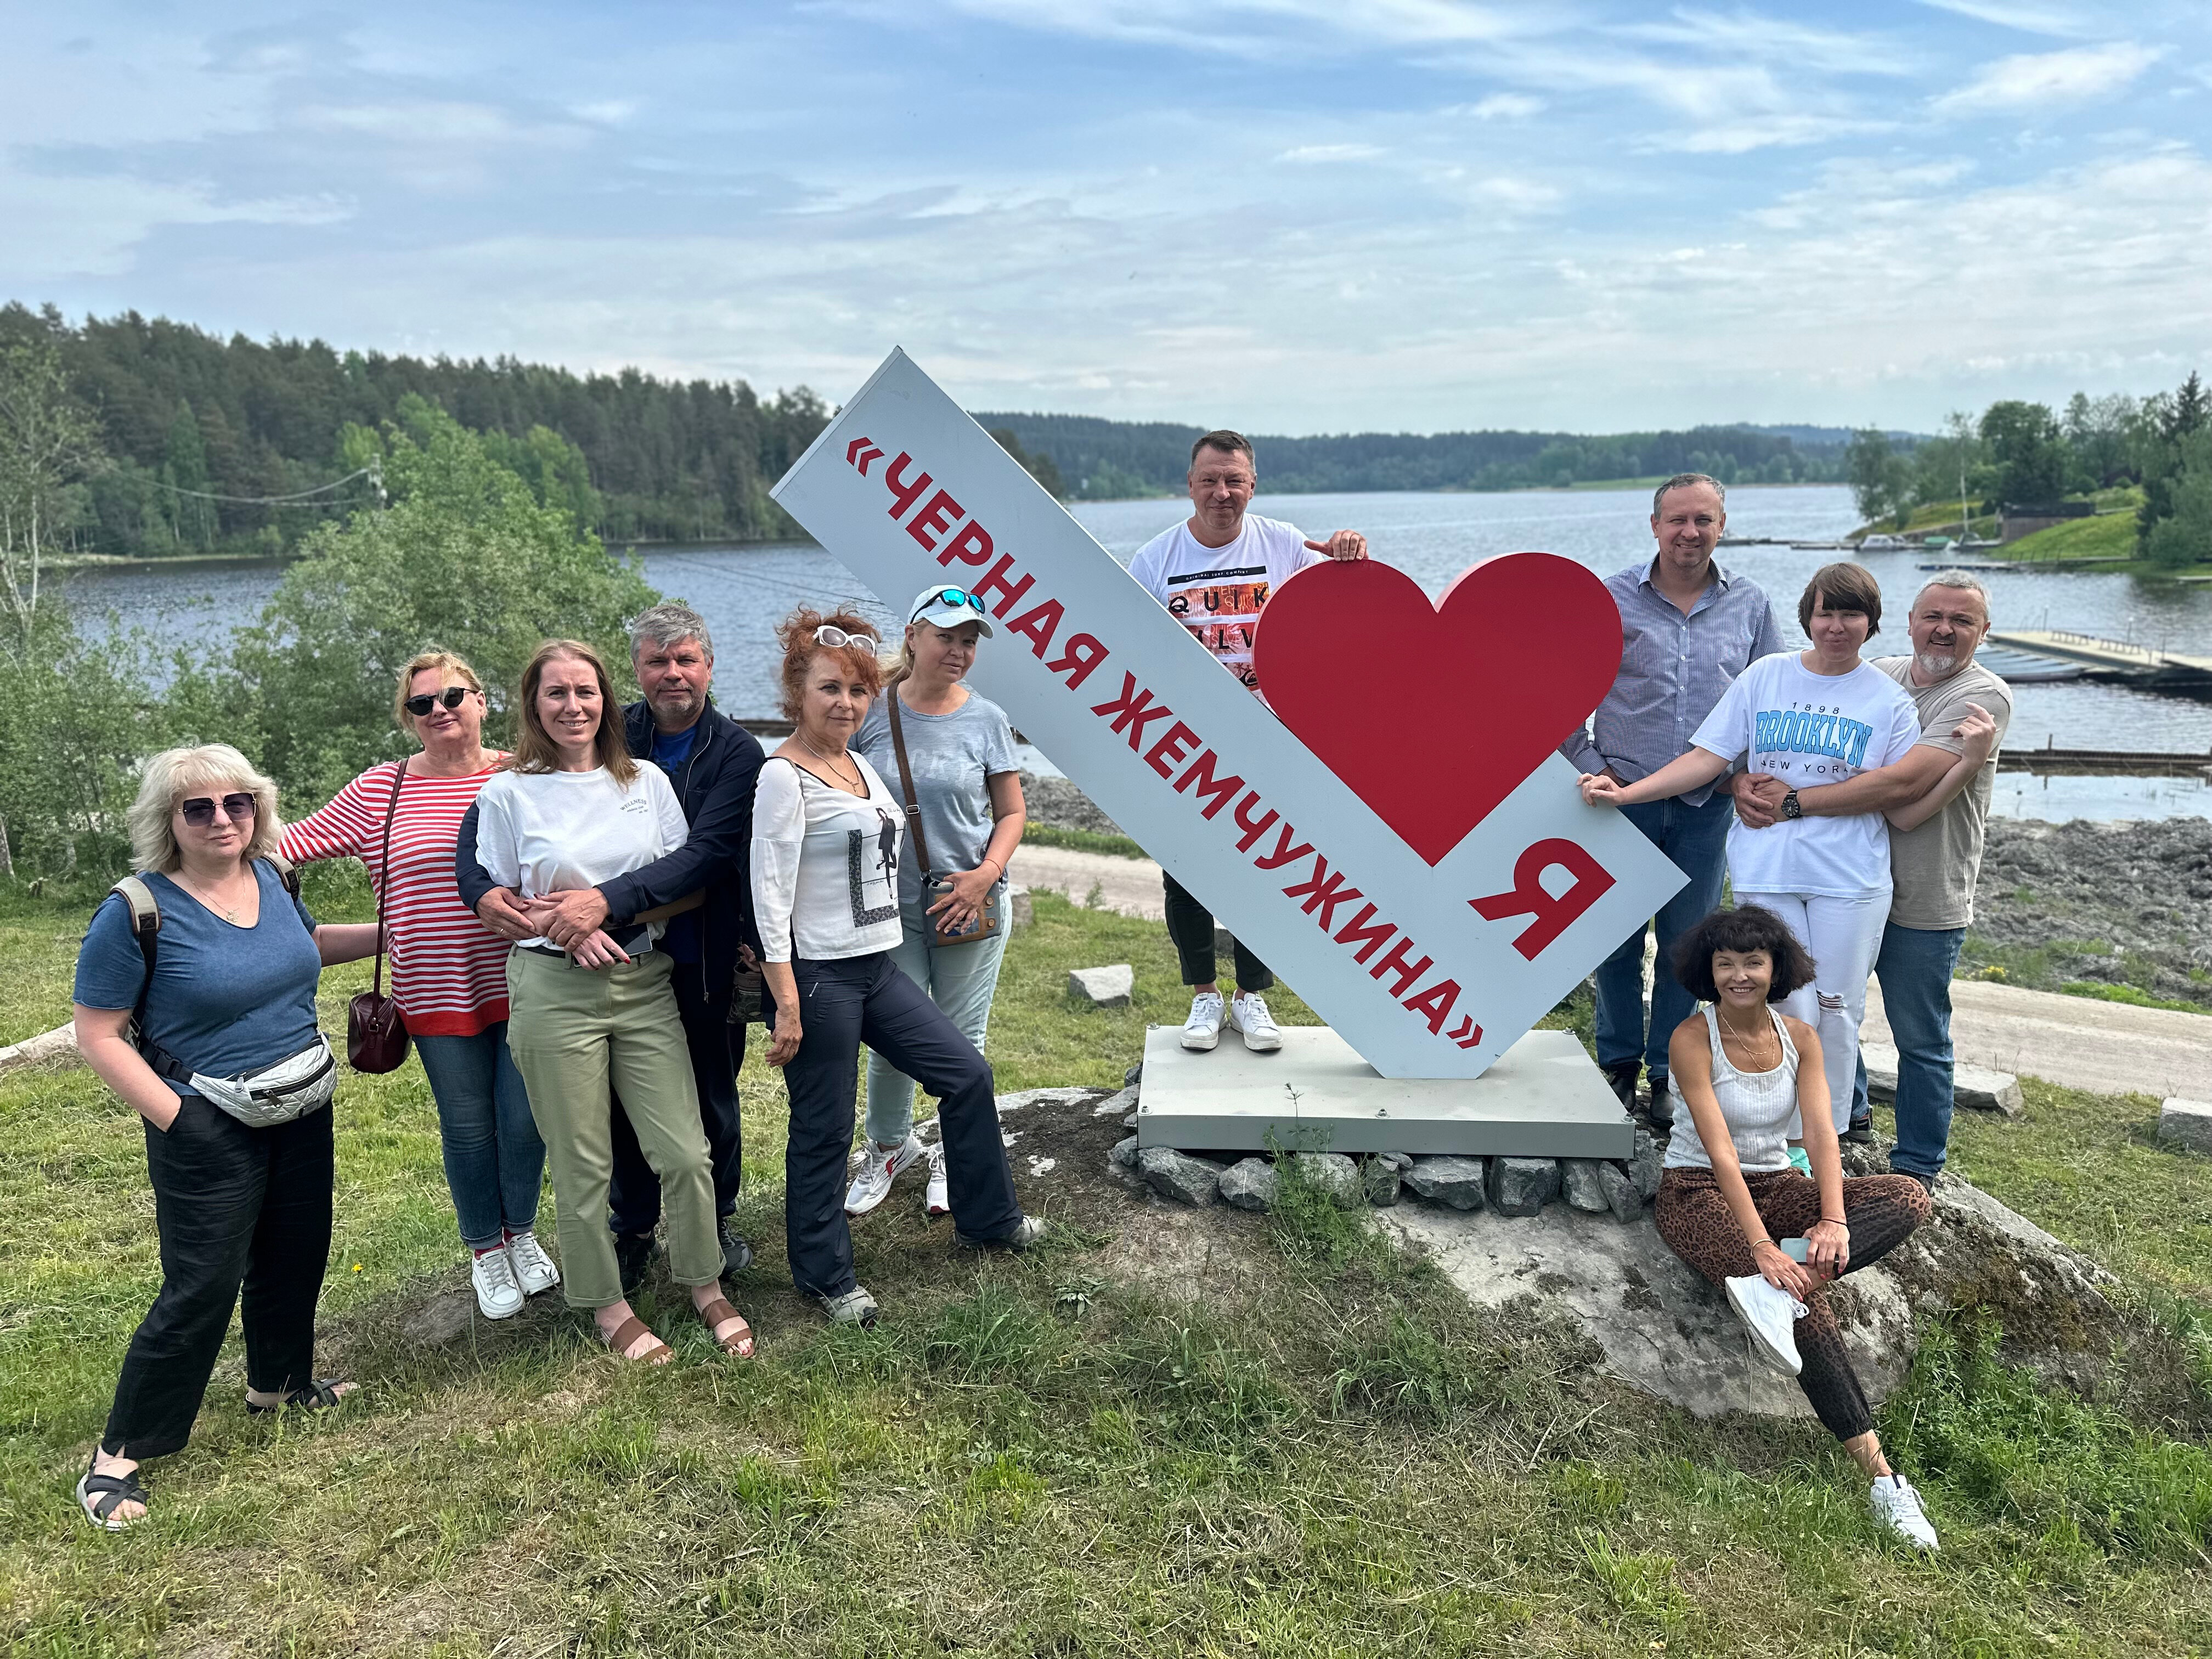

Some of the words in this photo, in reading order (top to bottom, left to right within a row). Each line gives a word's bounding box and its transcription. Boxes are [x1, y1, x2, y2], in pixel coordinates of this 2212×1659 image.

[1168, 586, 1268, 613] QUIK
[1792, 702, 1839, 714] 1898
[846, 437, 1110, 691] «ЧЕРНАЯ
[1090, 670, 1483, 1050] ЖЕМЧУЖИНА»
[1755, 710, 1873, 769] BROOKLYN
[620, 798, 647, 811] WELLNESS
[1467, 838, 1617, 961] Я
